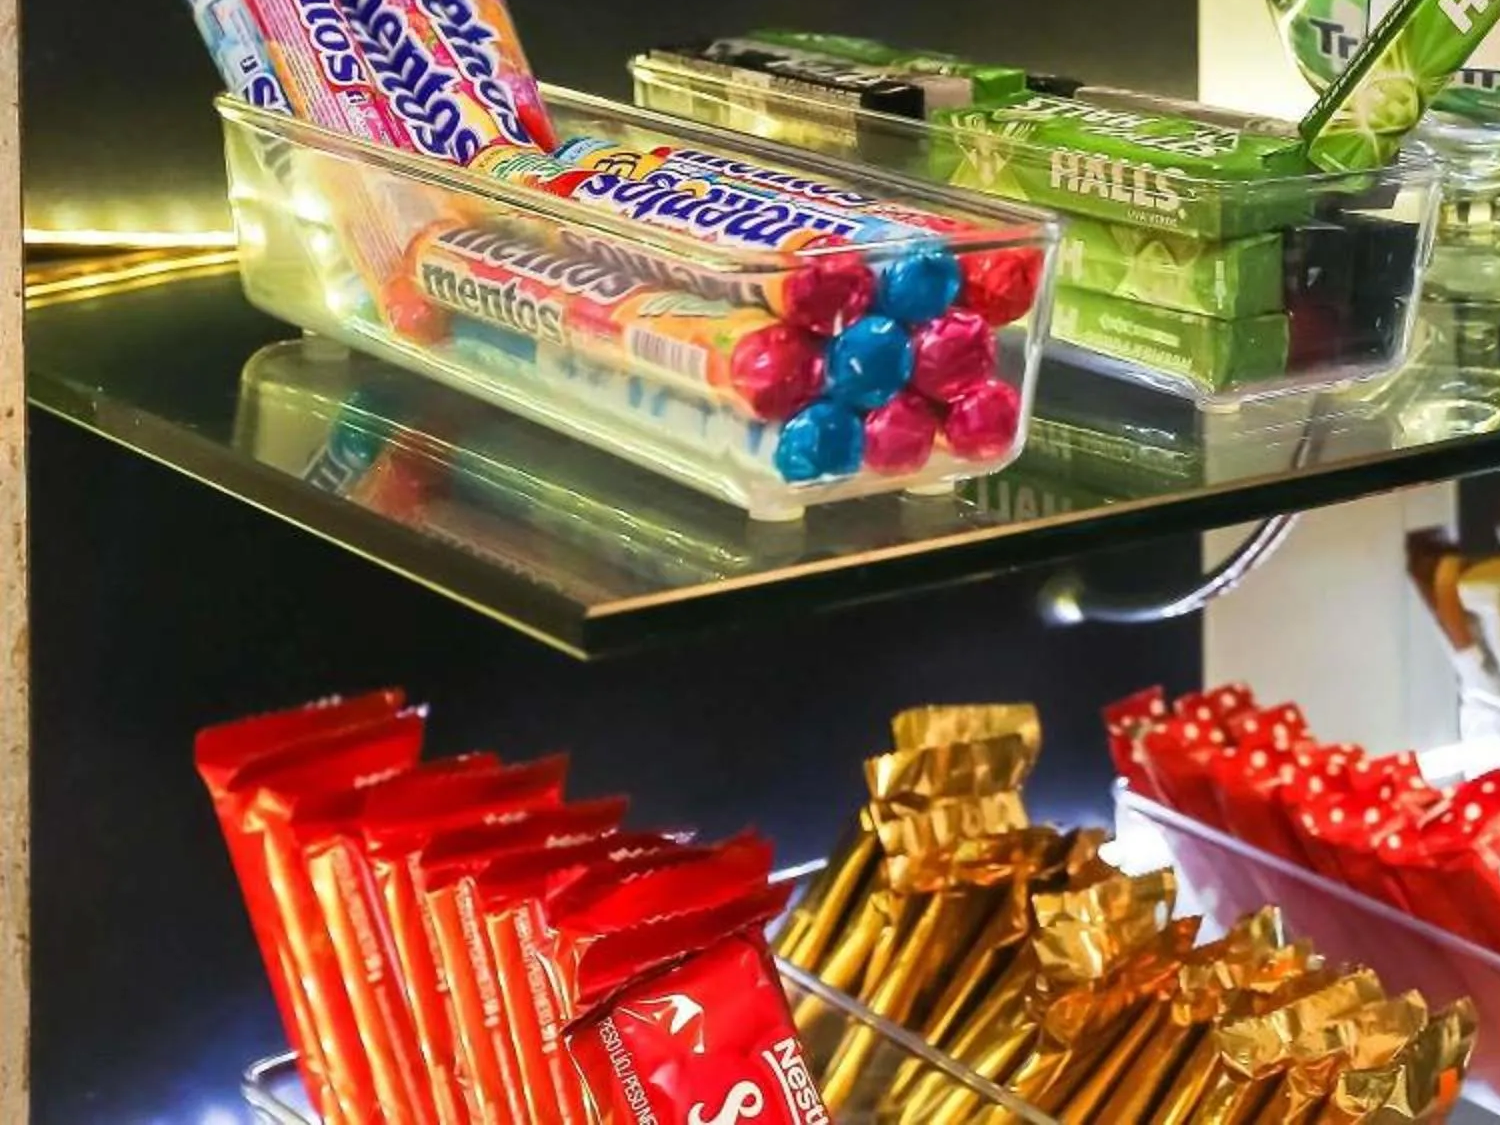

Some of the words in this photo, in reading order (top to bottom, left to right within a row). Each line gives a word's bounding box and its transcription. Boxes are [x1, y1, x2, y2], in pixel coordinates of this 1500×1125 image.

[582, 173, 791, 248] mentos
[1050, 147, 1182, 212] HALLS
[420, 259, 566, 344] mentos
[773, 1037, 831, 1125] Nestl
